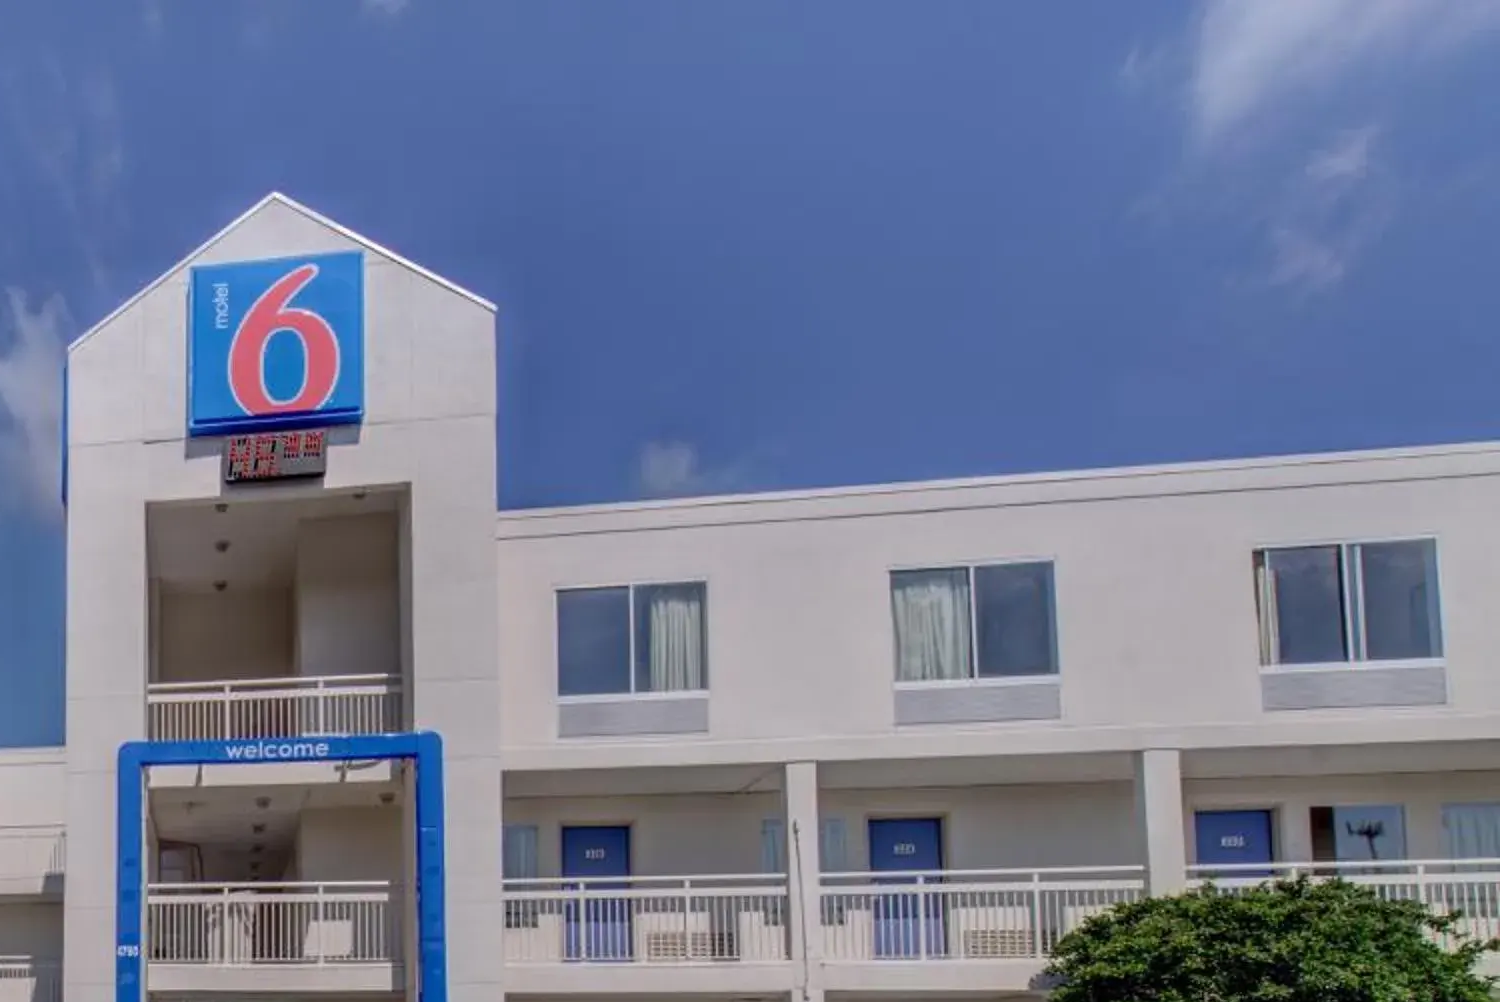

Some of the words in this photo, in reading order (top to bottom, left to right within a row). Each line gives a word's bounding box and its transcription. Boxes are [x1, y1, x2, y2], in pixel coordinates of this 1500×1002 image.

[211, 283, 229, 329] motel
[228, 263, 341, 416] 6
[225, 741, 330, 760] welcome
